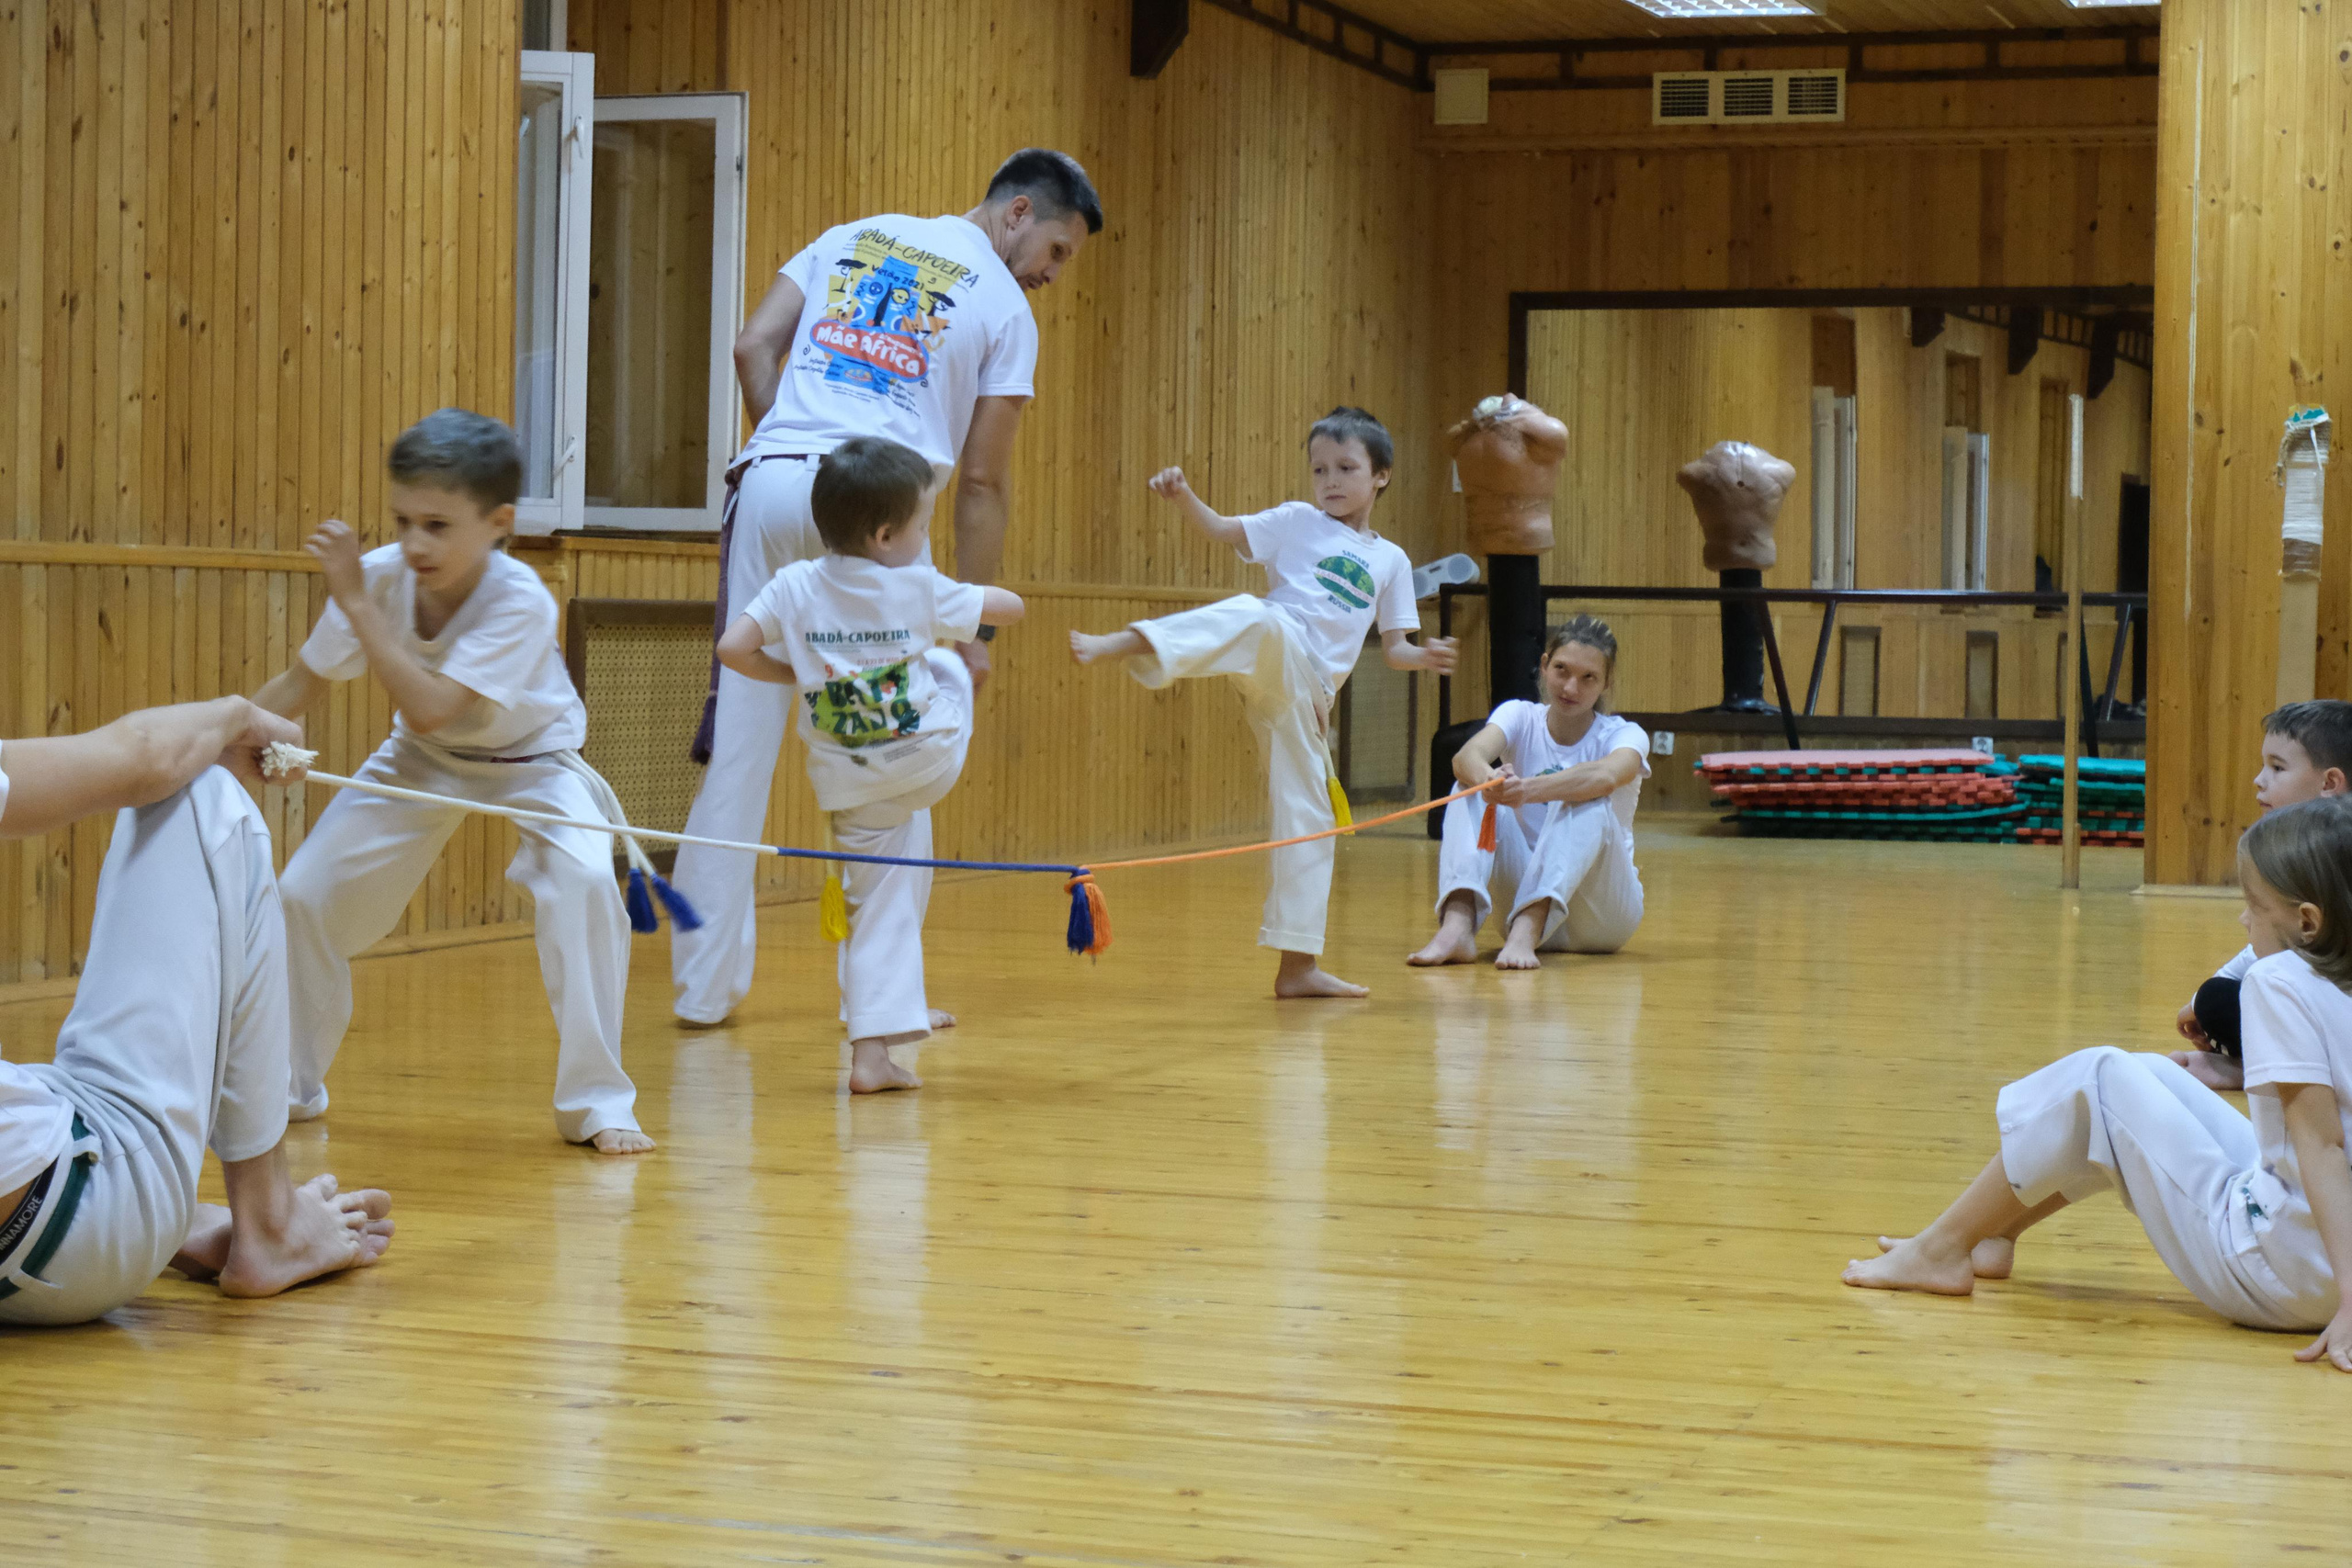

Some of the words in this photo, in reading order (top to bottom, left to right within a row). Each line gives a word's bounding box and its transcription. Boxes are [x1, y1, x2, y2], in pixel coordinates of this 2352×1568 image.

[850, 228, 979, 288] ABADÁ-CAPOEIRA
[816, 325, 858, 349] Mãe
[859, 331, 921, 377] África
[805, 629, 910, 644] ABADÁ-CAPOEIRA
